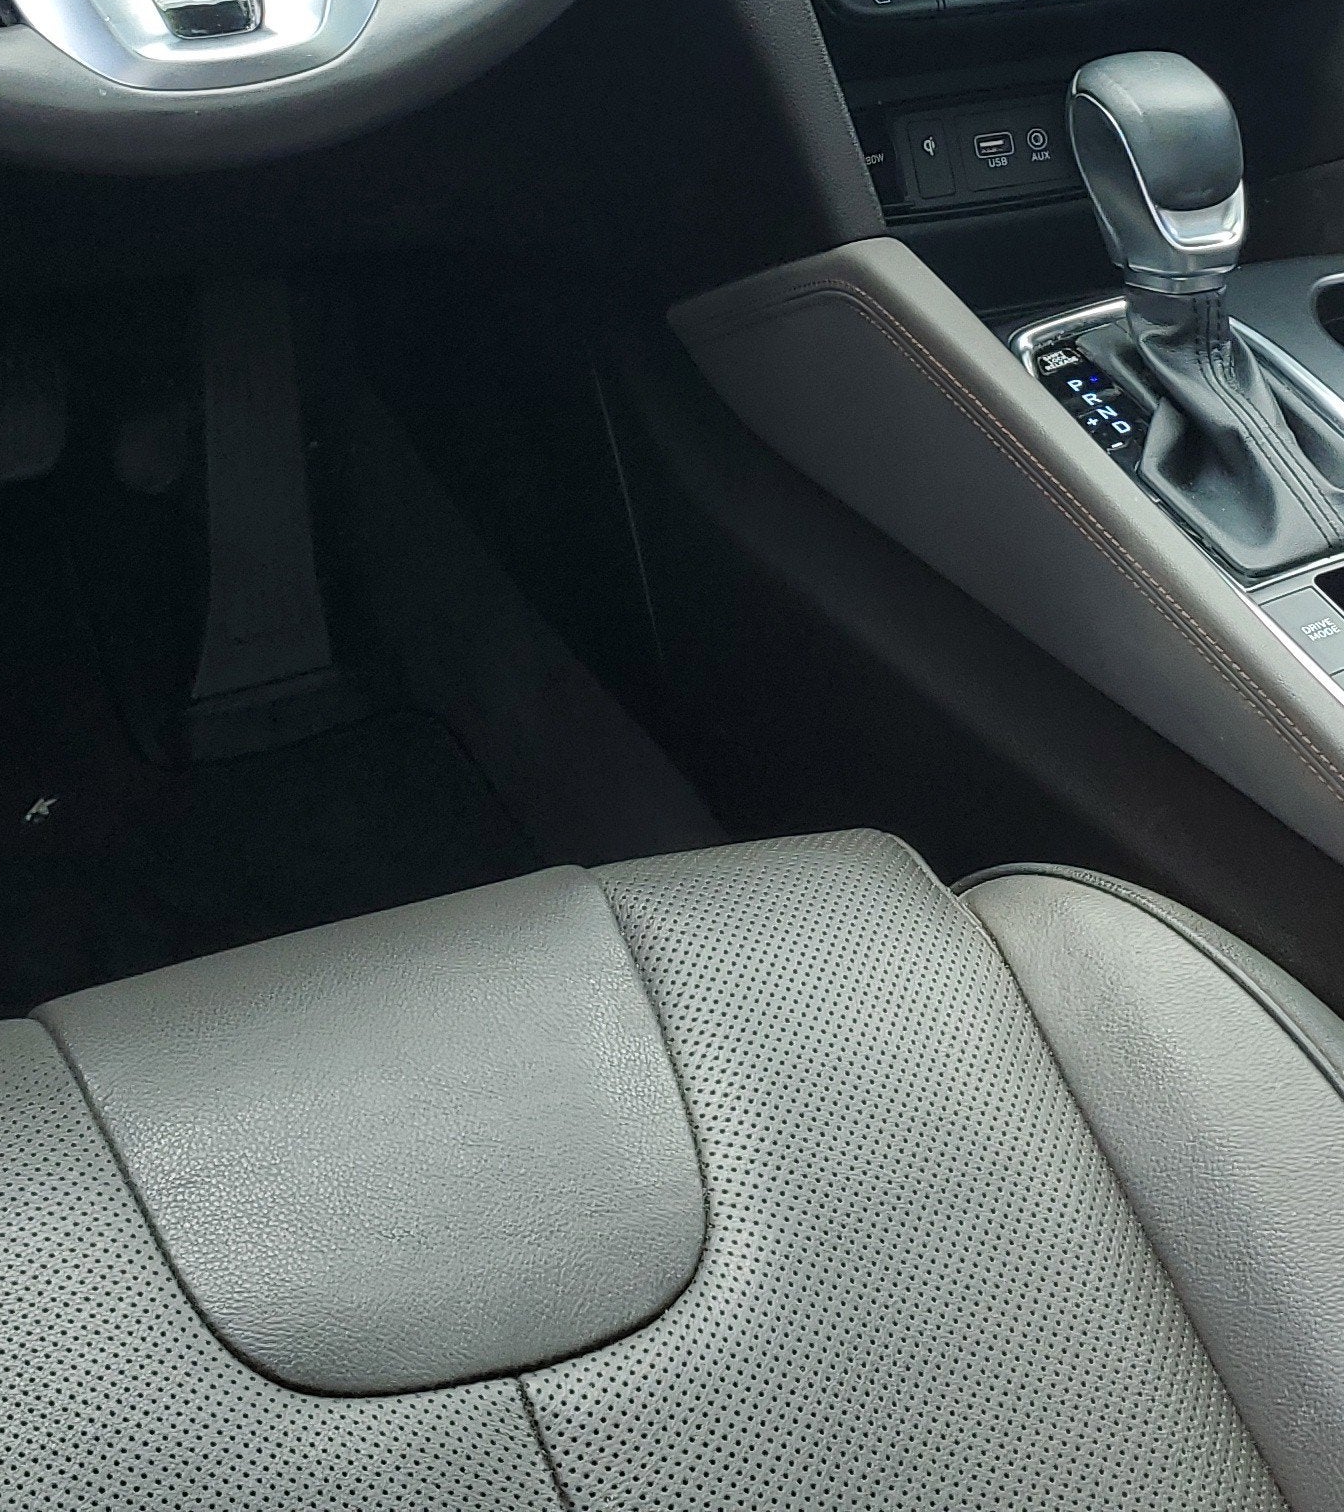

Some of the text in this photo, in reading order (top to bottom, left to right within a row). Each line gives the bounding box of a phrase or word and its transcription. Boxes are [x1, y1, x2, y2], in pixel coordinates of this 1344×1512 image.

[988, 157, 1008, 168] USB
[1031, 150, 1051, 162] AUX
[1067, 379, 1083, 392] P
[1082, 392, 1103, 406] R
[1096, 405, 1119, 420] N
[1111, 420, 1131, 434] D
[1301, 617, 1335, 635] DRIVE
[1307, 624, 1342, 641] MODE
